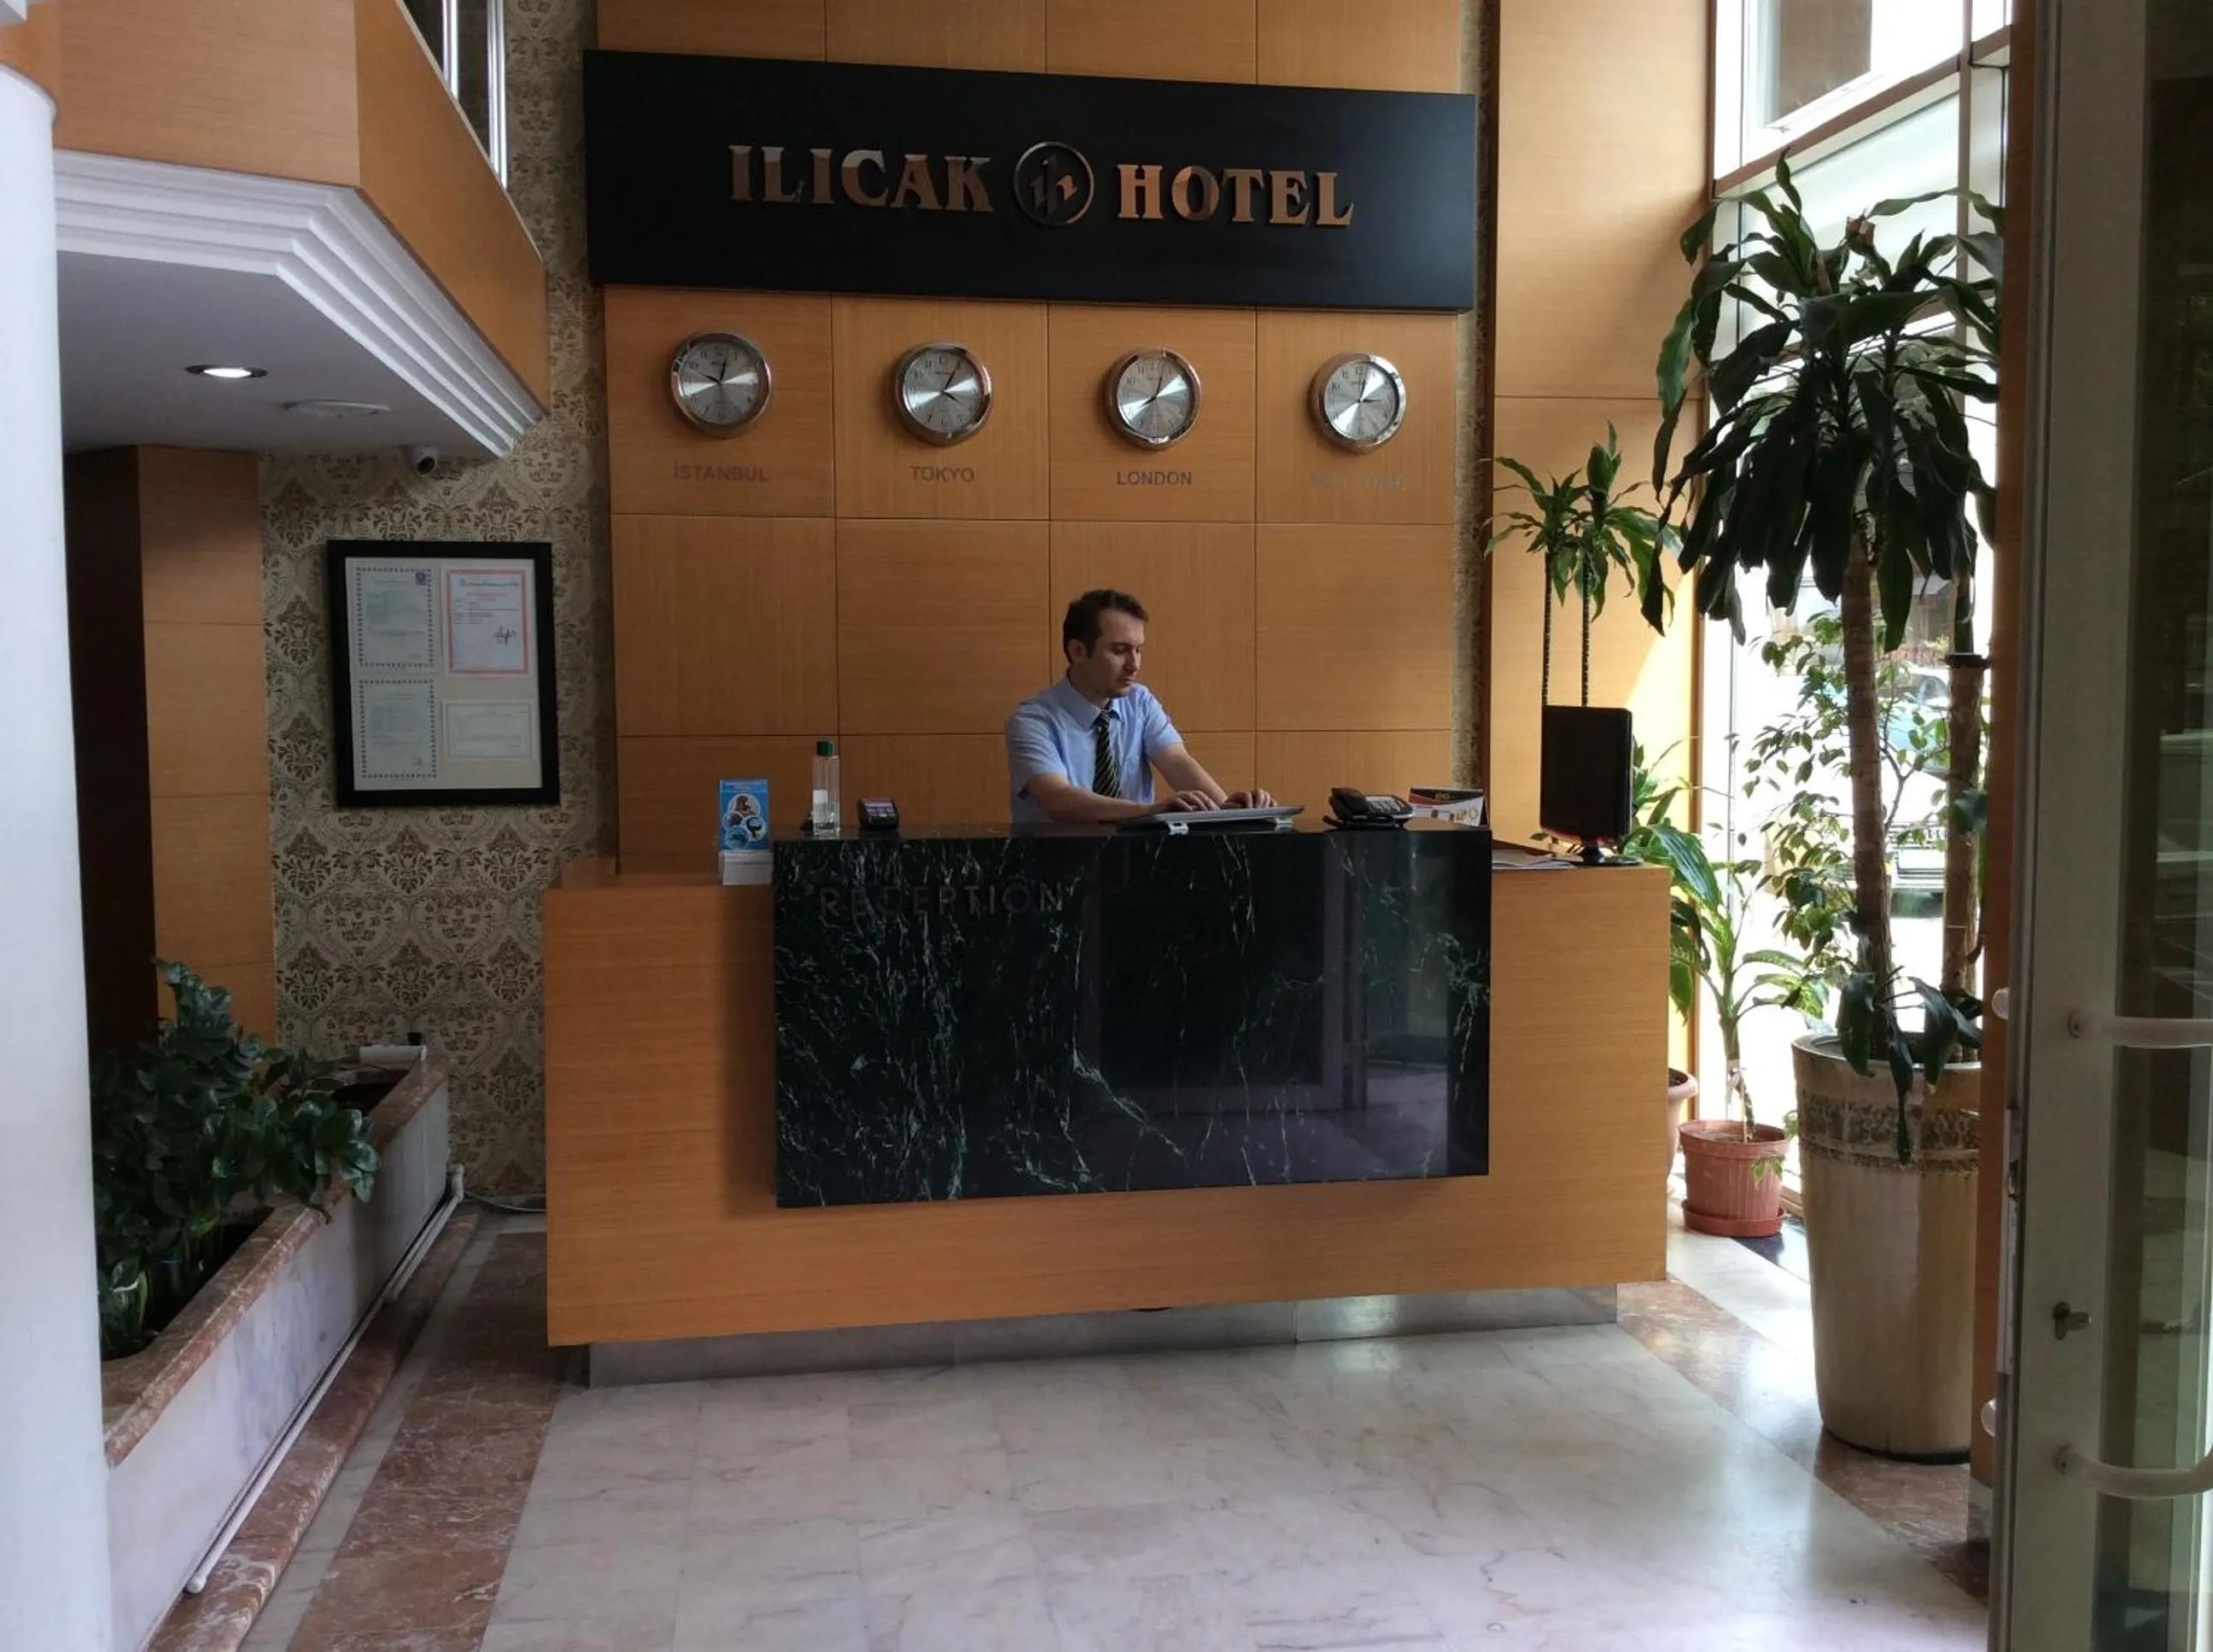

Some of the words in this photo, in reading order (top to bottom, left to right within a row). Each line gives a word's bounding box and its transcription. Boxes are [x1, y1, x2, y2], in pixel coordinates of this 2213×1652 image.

[728, 143, 995, 213] ILICAK
[1116, 163, 1355, 227] HOTEL
[909, 465, 975, 483] TOKYO
[1116, 470, 1193, 487] LONDON
[819, 882, 1064, 916] RECEPTION
